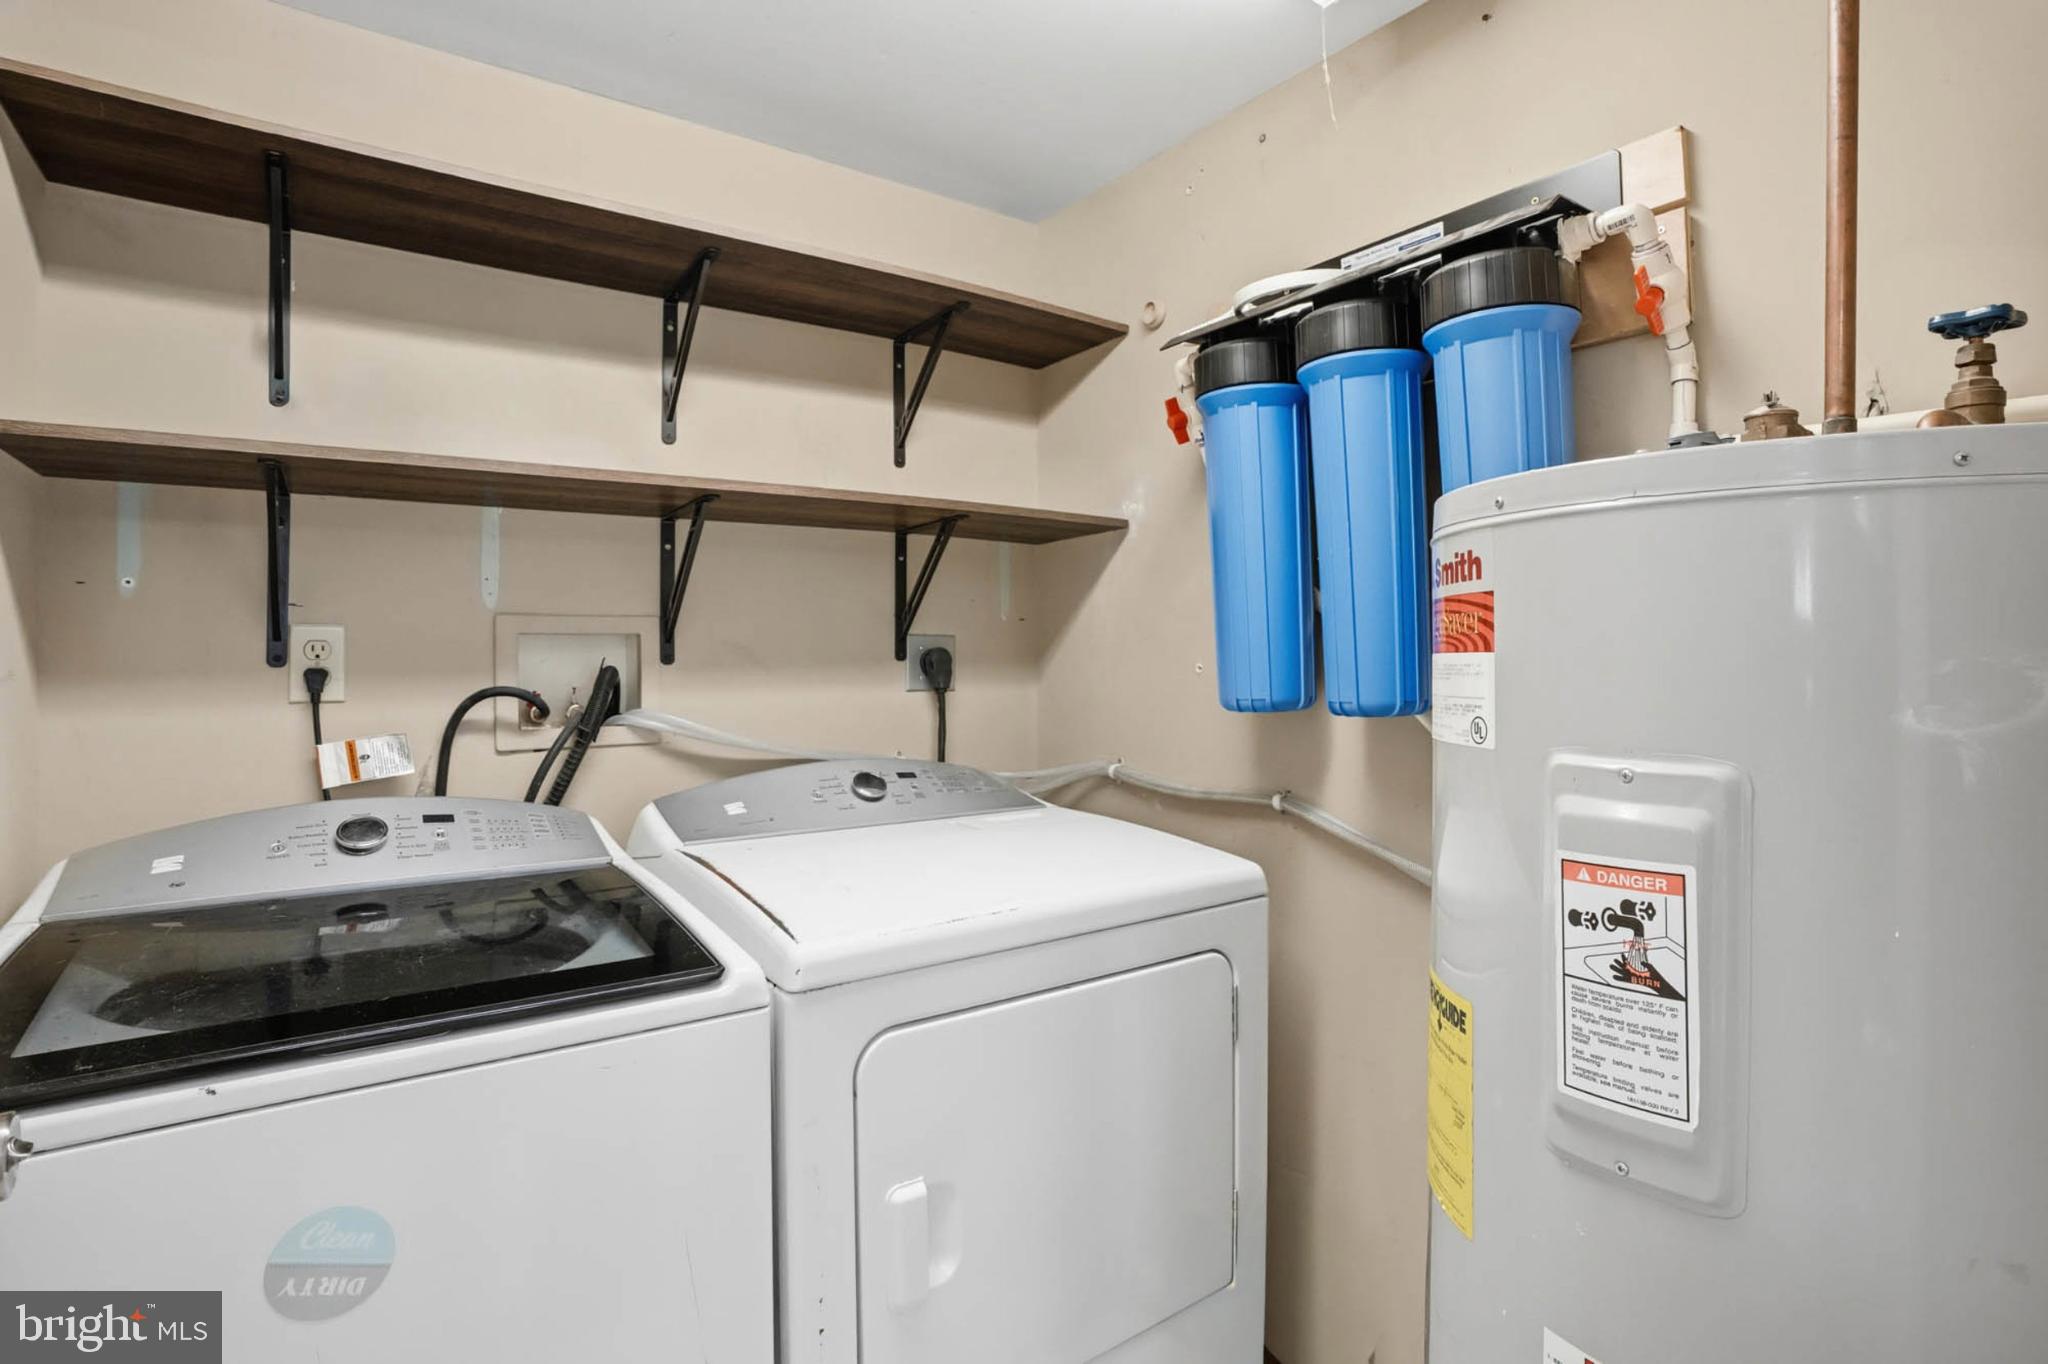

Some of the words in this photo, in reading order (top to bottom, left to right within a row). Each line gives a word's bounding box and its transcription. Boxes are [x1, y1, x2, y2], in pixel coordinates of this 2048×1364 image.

[1435, 549, 1482, 588] Smith
[1596, 870, 1668, 892] DANGER
[1630, 975, 1661, 989] BURN
[1588, 988, 1624, 1003] temperature
[1598, 1014, 1625, 1026] disabled
[1626, 1021, 1640, 1030] and
[1571, 1023, 1583, 1032] See
[1625, 1039, 1650, 1050] manual
[1656, 1045, 1679, 1056] before
[1597, 1037, 1636, 1052] temperature
[1659, 1054, 1679, 1062] water
[1589, 1053, 1606, 1062] water
[1612, 1058, 1633, 1070] before
[1639, 1066, 1665, 1079] bathing
[1571, 1063, 1608, 1080] Temperature
[1641, 1085, 1663, 1096] valves
[1599, 1079, 1612, 1088] see
[300, 1220, 377, 1251] Clean
[278, 1275, 369, 1297] DIRTY
